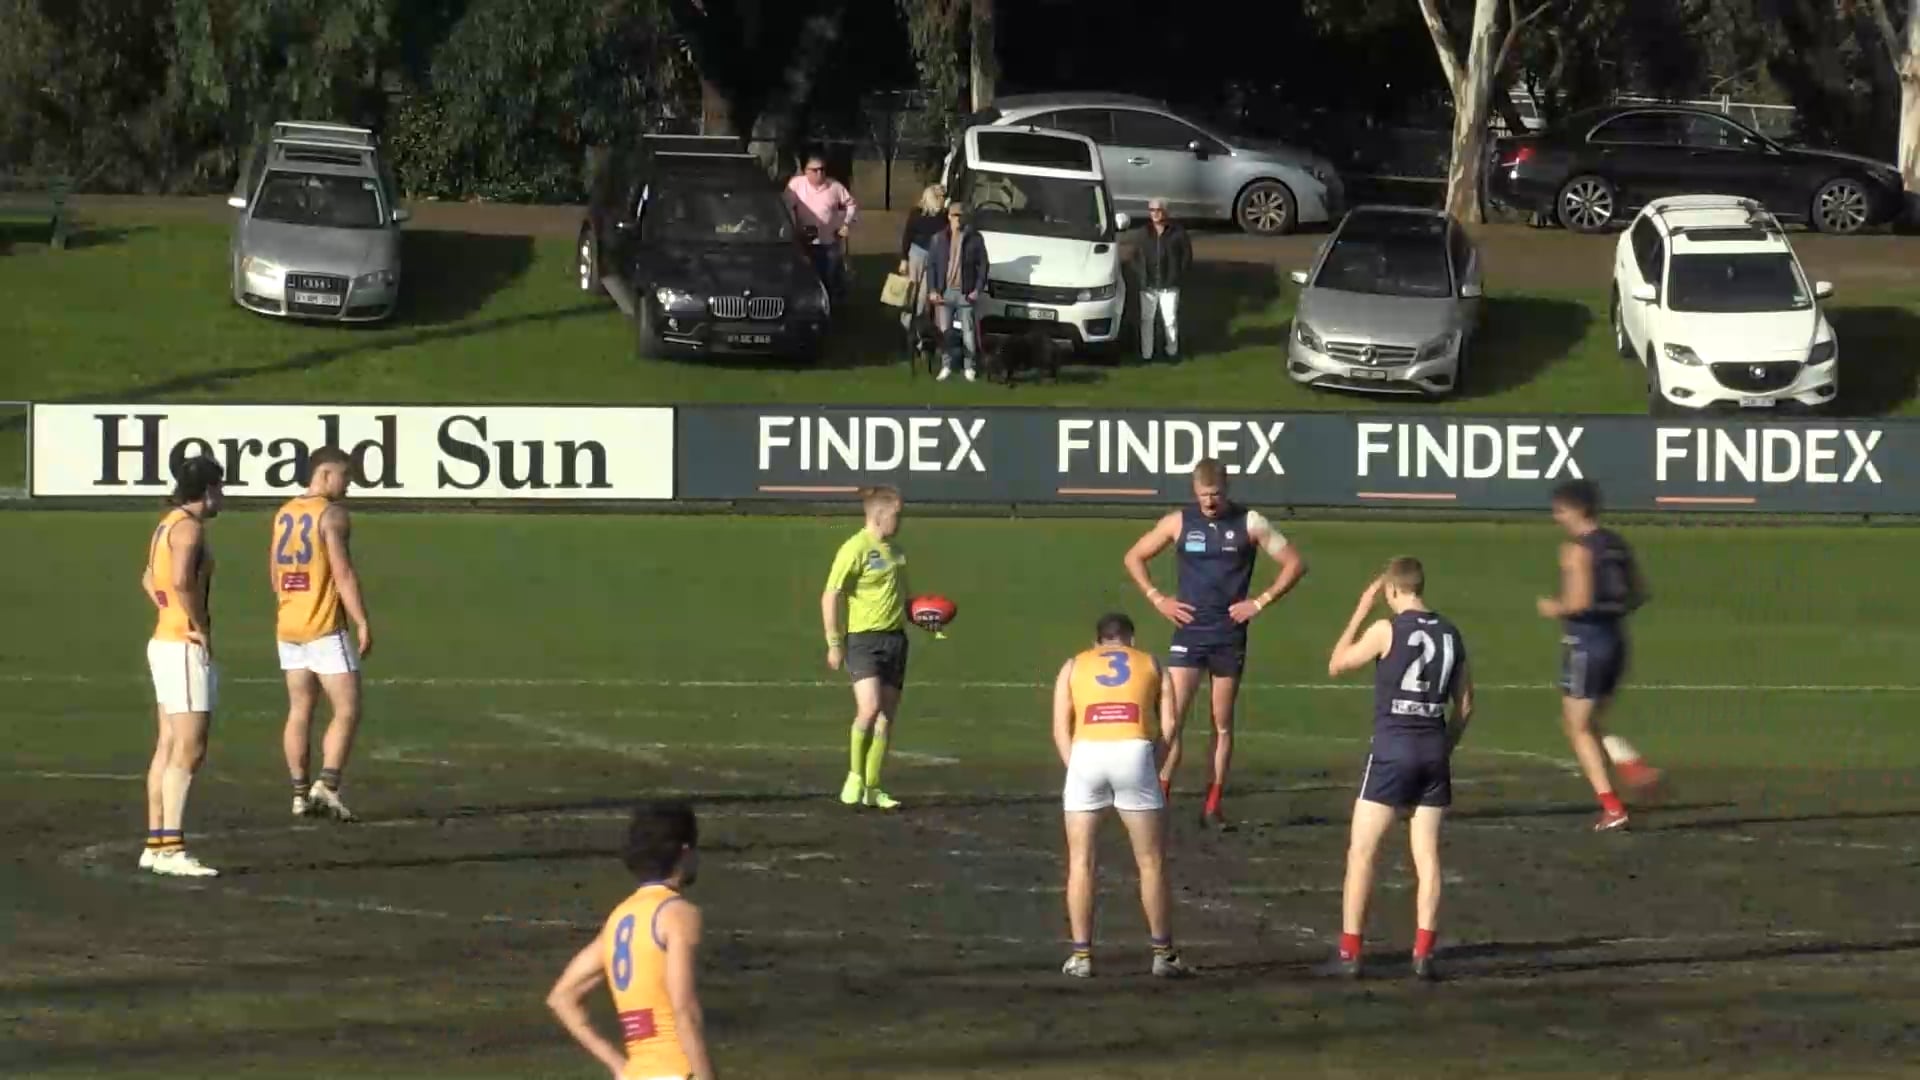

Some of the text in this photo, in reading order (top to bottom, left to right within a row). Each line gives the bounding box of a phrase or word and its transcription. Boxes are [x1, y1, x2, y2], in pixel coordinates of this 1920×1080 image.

[437, 414, 613, 490] Sun
[758, 415, 986, 472] FINDEX
[1058, 419, 1285, 475] FINDEX
[1357, 422, 1585, 480] FINDEX
[1656, 427, 1883, 484] FINDEX
[276, 512, 313, 565] 23
[1095, 650, 1132, 687] 3
[1400, 629, 1455, 695] 21
[613, 914, 635, 991] 8
